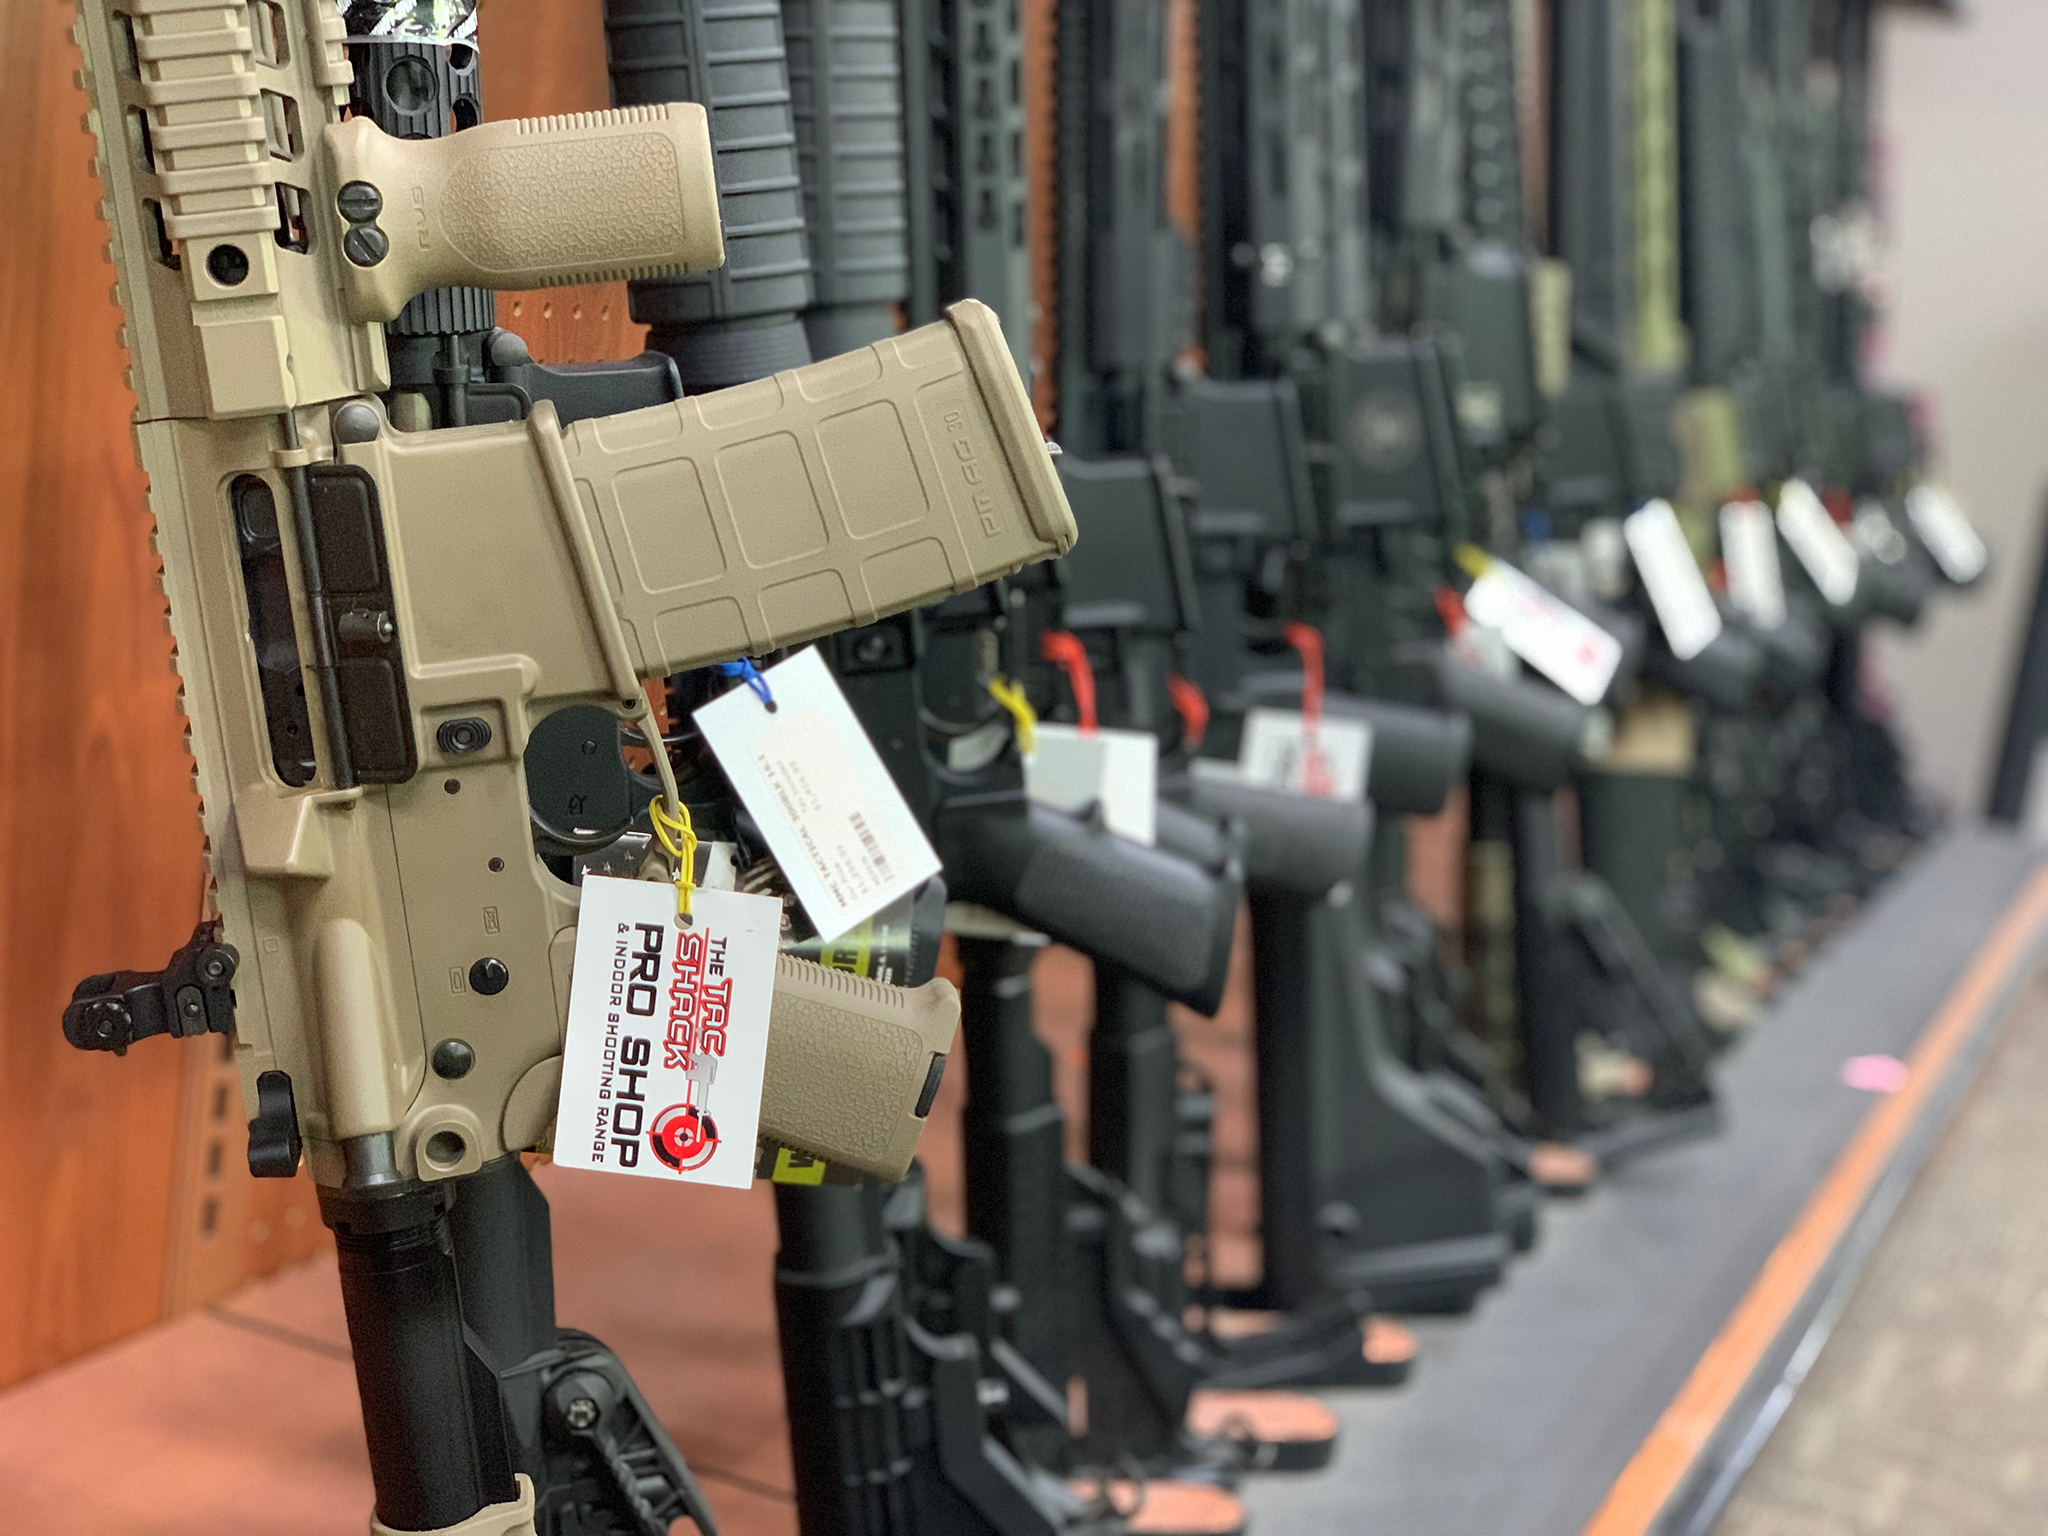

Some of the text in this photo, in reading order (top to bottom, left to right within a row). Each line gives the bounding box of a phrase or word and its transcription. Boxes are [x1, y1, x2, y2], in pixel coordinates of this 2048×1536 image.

[796, 823, 832, 879] TACTICAL
[591, 923, 629, 1163] & INDOOR SHOOTING RANGE
[610, 922, 664, 1169] PRO SHOP
[661, 932, 701, 1074] SHACK
[699, 936, 733, 1058] THE TAC
